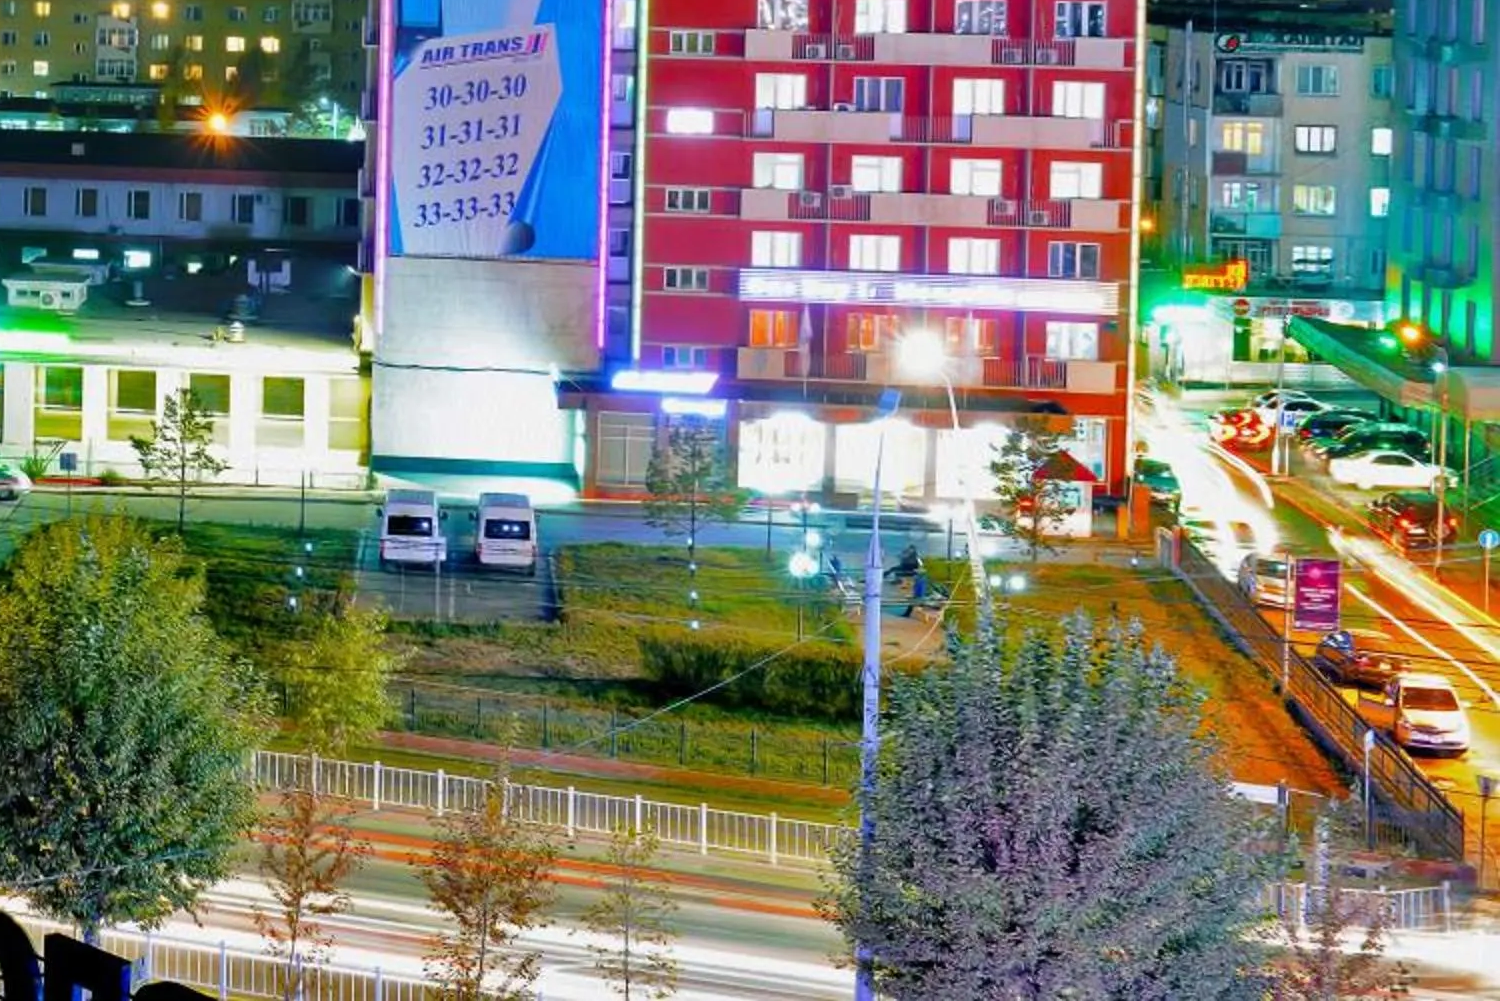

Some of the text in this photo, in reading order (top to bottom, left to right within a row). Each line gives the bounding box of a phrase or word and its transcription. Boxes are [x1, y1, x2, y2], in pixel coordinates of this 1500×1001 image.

[421, 36, 523, 64] AIR TRANS
[424, 73, 527, 110] 30-30-30
[421, 114, 521, 150] 31-31-31
[417, 153, 519, 189] 32-32-32
[414, 192, 516, 228] 33-33-33
